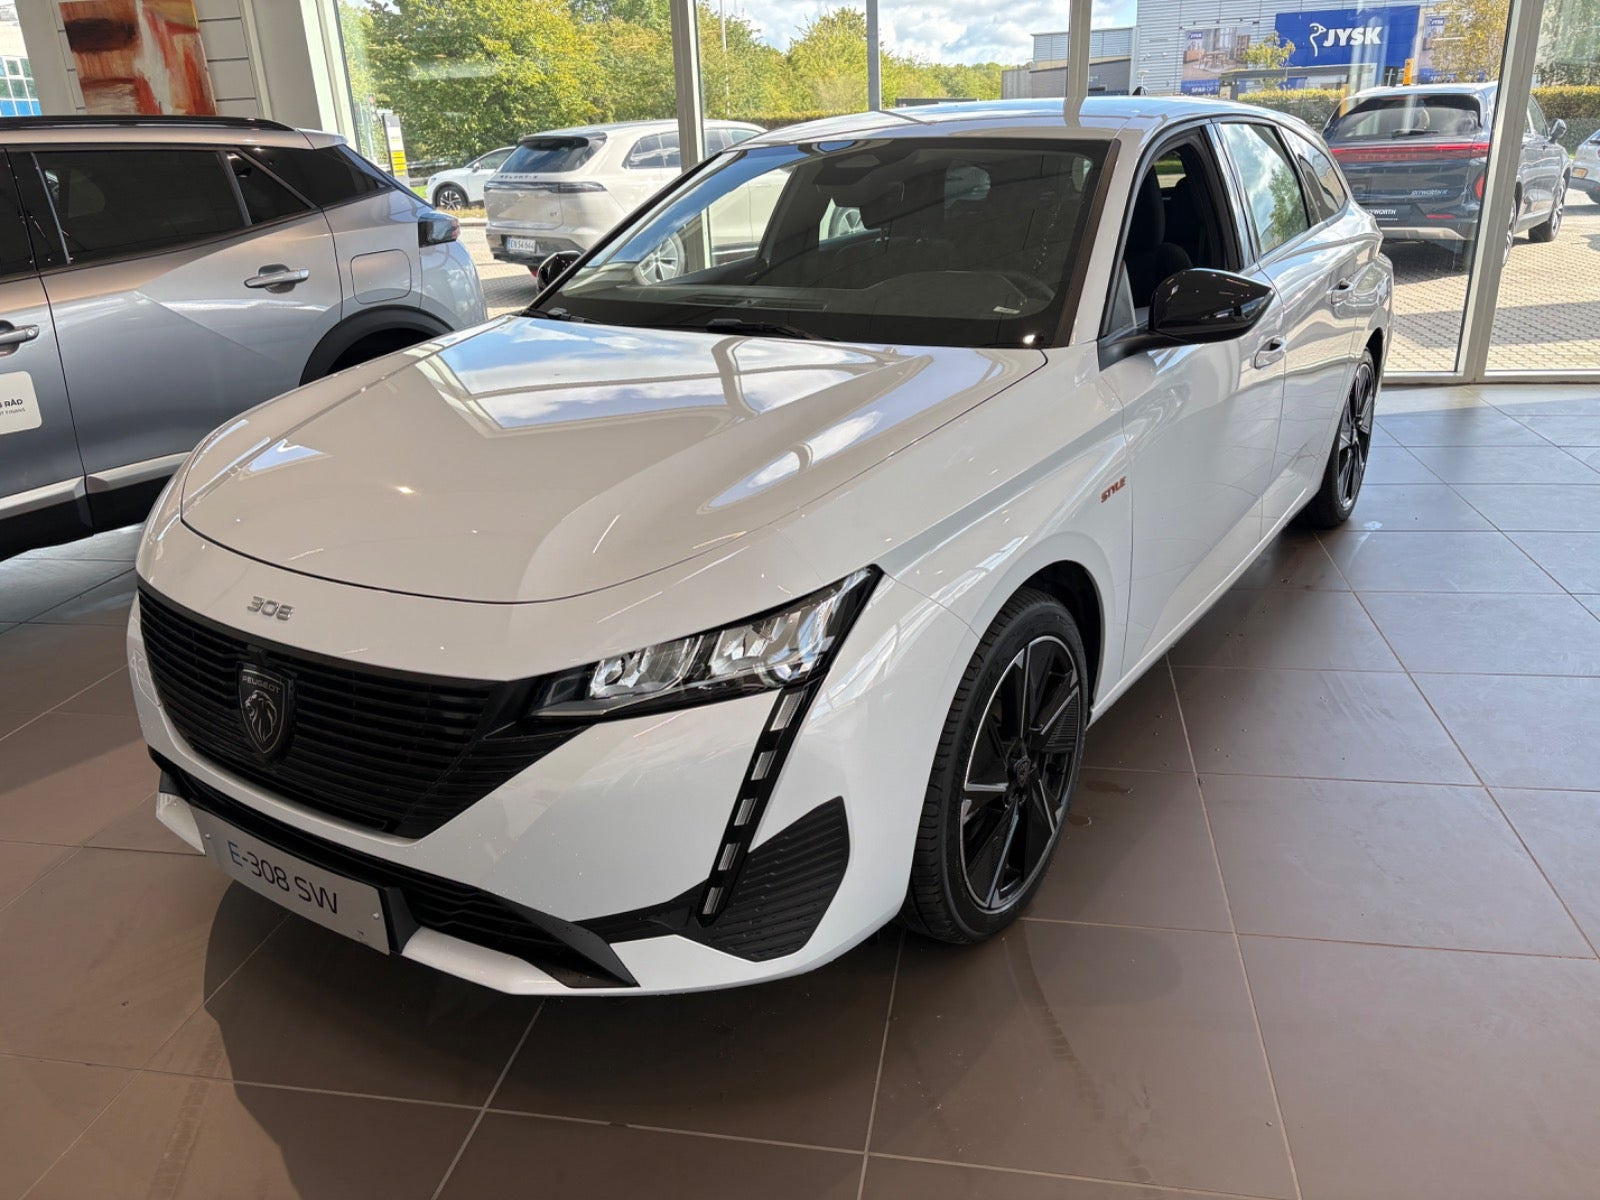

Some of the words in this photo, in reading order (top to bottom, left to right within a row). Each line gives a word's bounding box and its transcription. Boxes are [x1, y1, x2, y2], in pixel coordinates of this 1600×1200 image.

[1323, 26, 1383, 47] JYSK
[1101, 476, 1126, 503] STYLE
[247, 596, 295, 621] 308
[242, 675, 281, 694] PEUGEOT
[227, 840, 290, 892] E-308
[294, 875, 338, 914] SW
